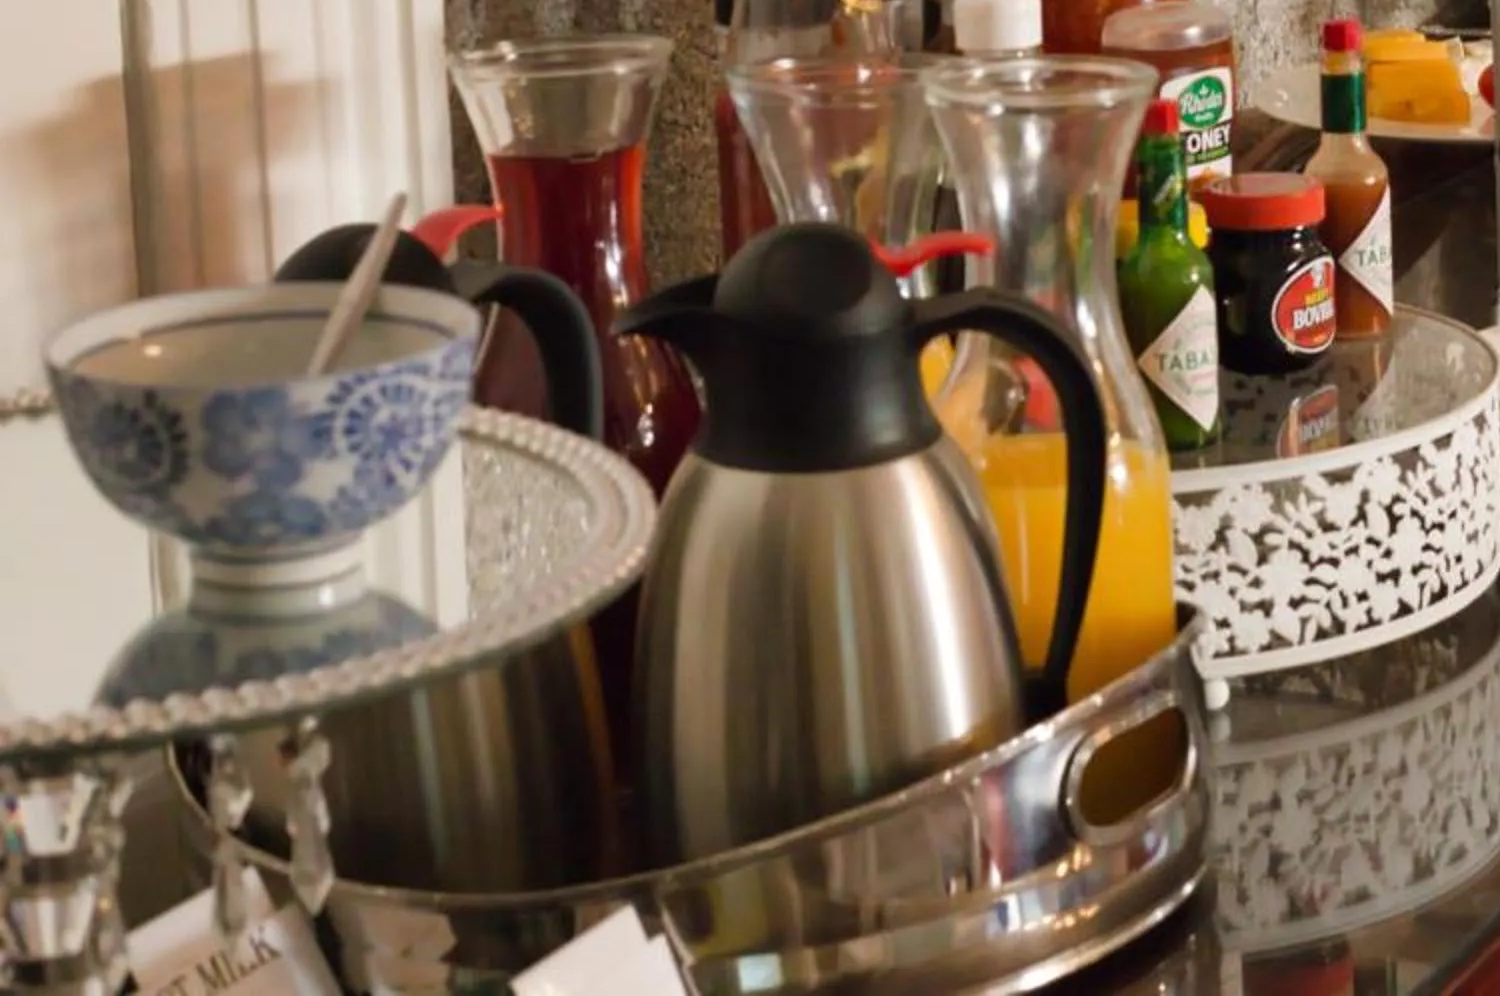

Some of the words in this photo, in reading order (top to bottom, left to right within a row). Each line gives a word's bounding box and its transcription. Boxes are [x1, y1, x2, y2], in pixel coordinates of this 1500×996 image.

[1185, 123, 1232, 154] ONEY
[1353, 245, 1388, 267] TAB
[1153, 349, 1216, 372] TABA
